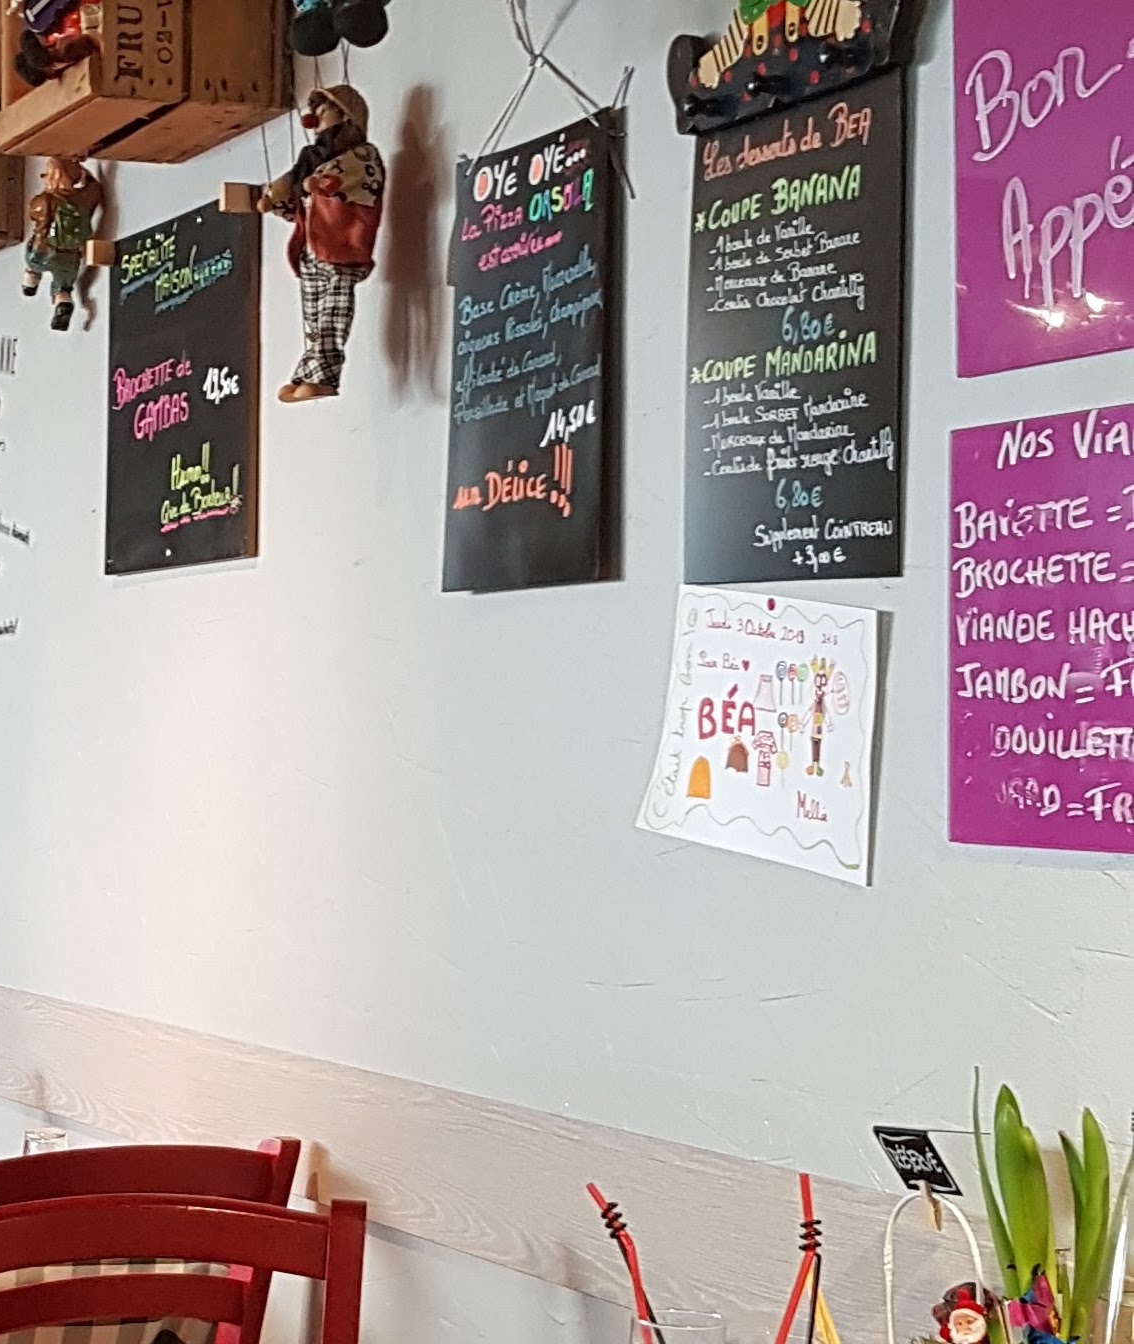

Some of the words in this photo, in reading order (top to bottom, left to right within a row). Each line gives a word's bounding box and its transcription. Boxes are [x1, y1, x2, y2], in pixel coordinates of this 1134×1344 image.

[965, 48, 1124, 162] Bon
[703, 140, 733, 182] Les
[736, 119, 796, 170] desserts
[800, 116, 822, 152] de
[827, 101, 873, 147] BEA
[770, 164, 862, 216] BANANA
[725, 229, 754, 253] boule
[756, 227, 771, 244] de
[774, 216, 815, 242] Vanille
[1002, 135, 1134, 311] Appé
[724, 252, 752, 272] boule
[755, 251, 771, 265] de
[814, 230, 861, 254] Banane
[769, 269, 786, 284] de
[787, 261, 838, 282] Banane
[458, 295, 495, 326] Base
[782, 305, 836, 345] 6,80€
[176, 350, 193, 378] de
[722, 383, 754, 406] boule
[754, 380, 802, 402] Vanille
[133, 392, 190, 441] GAMBAS
[721, 407, 751, 427] boule
[768, 429, 785, 444] de
[775, 478, 823, 514] 6,80€
[952, 552, 1116, 599] BROCHETTE
[955, 662, 1071, 704] JAMBON
[697, 683, 756, 740] BÉA
